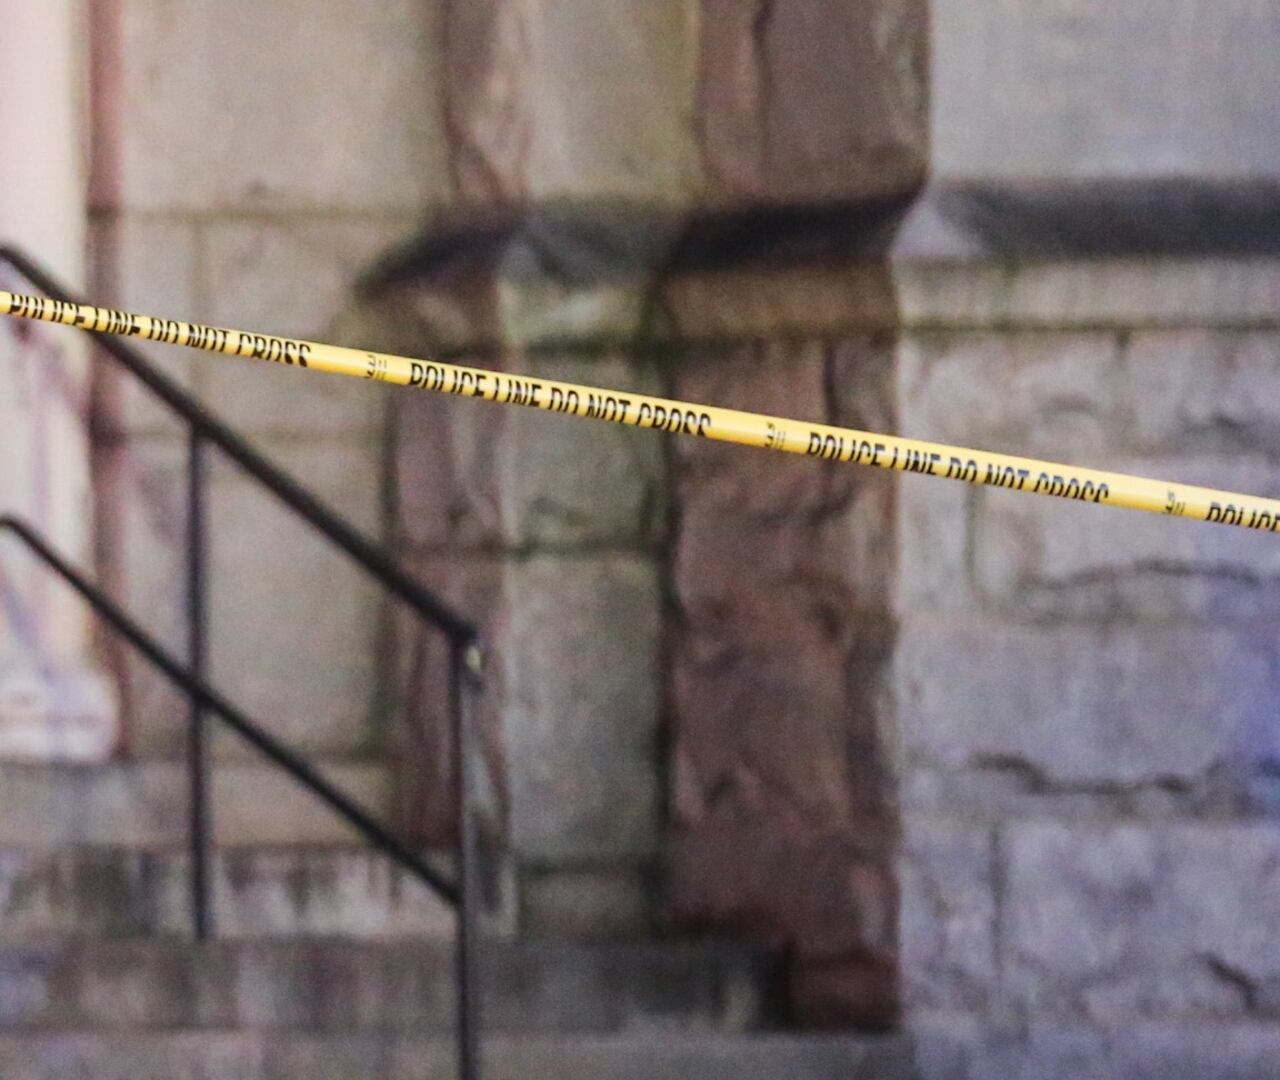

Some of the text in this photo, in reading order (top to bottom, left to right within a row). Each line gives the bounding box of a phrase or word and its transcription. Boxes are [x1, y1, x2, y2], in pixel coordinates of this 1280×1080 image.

[409, 362, 711, 437] POLICE LINE DO NOT CROSS
[808, 431, 1109, 504] POLICE LINE DO NOT CROSS
